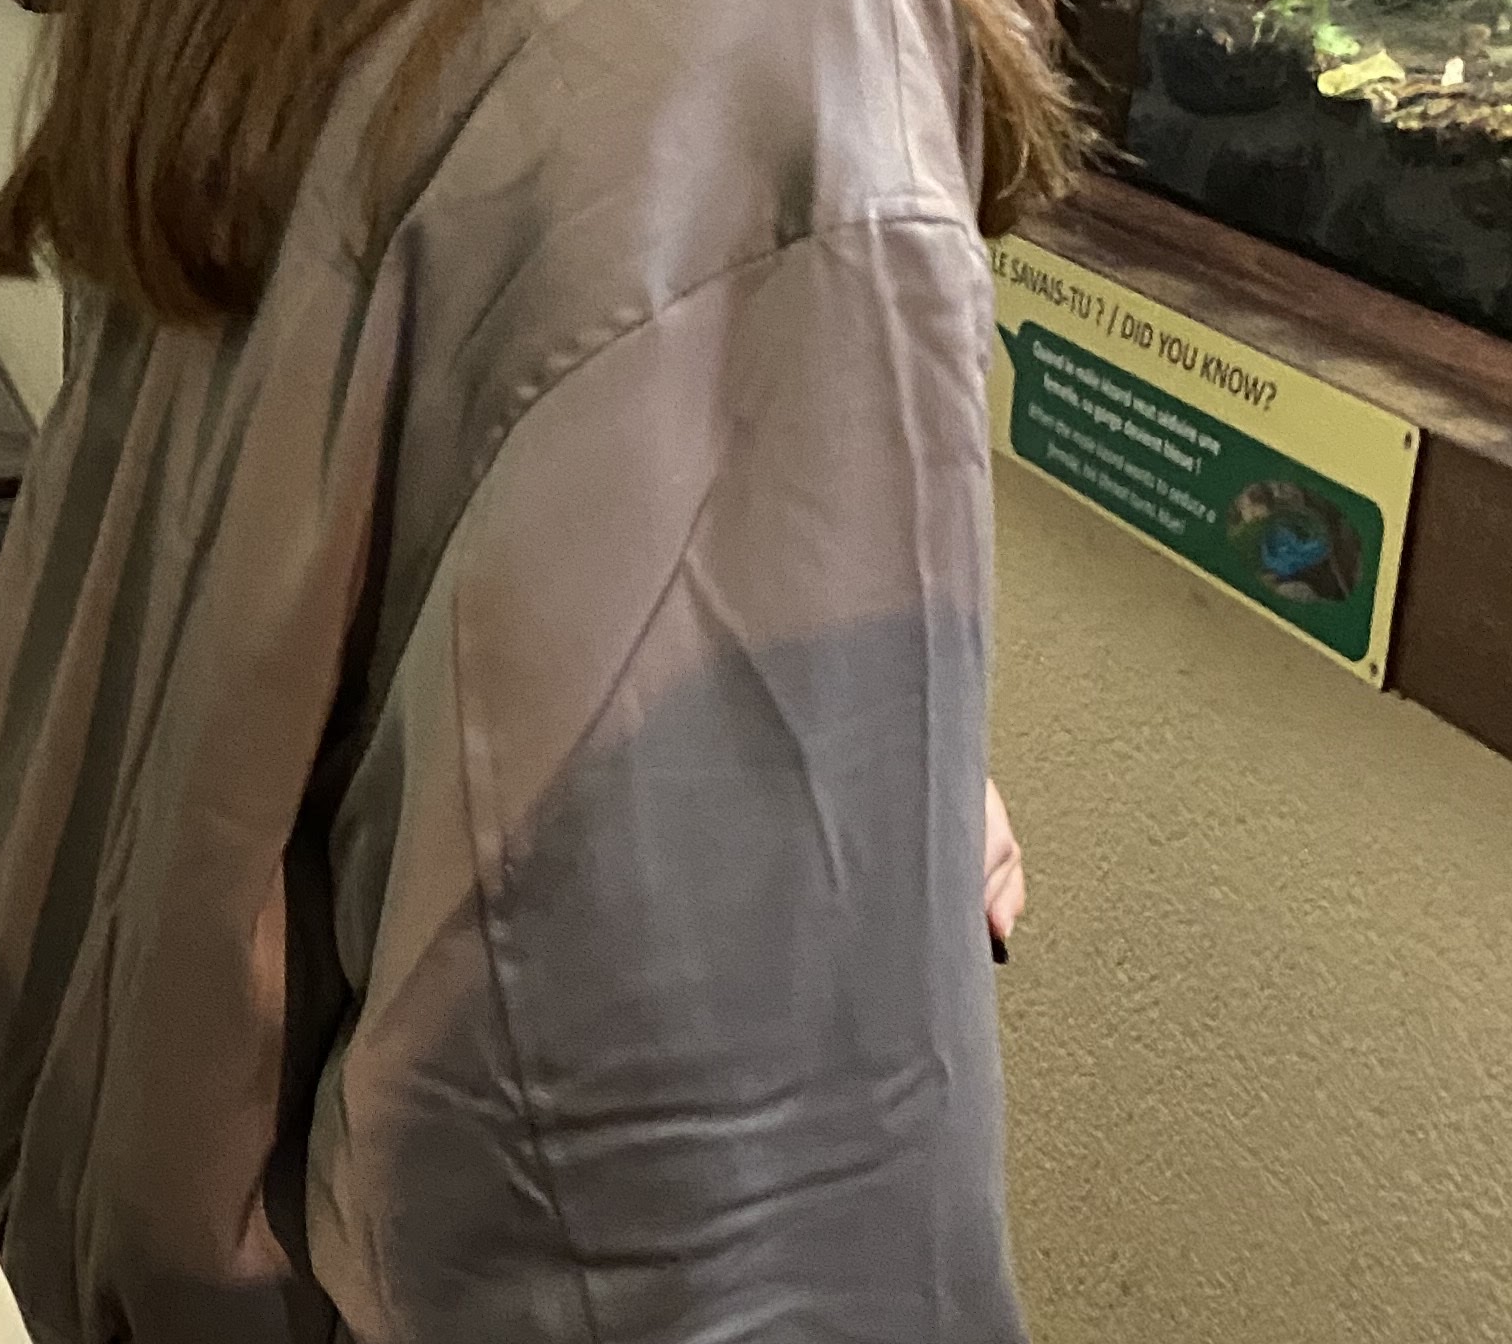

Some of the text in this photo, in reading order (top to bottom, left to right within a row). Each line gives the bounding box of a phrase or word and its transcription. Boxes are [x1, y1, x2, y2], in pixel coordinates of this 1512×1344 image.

[1120, 312, 1154, 348] DID
[1158, 331, 1199, 371] YOU
[1199, 352, 1278, 412] KNOW?
